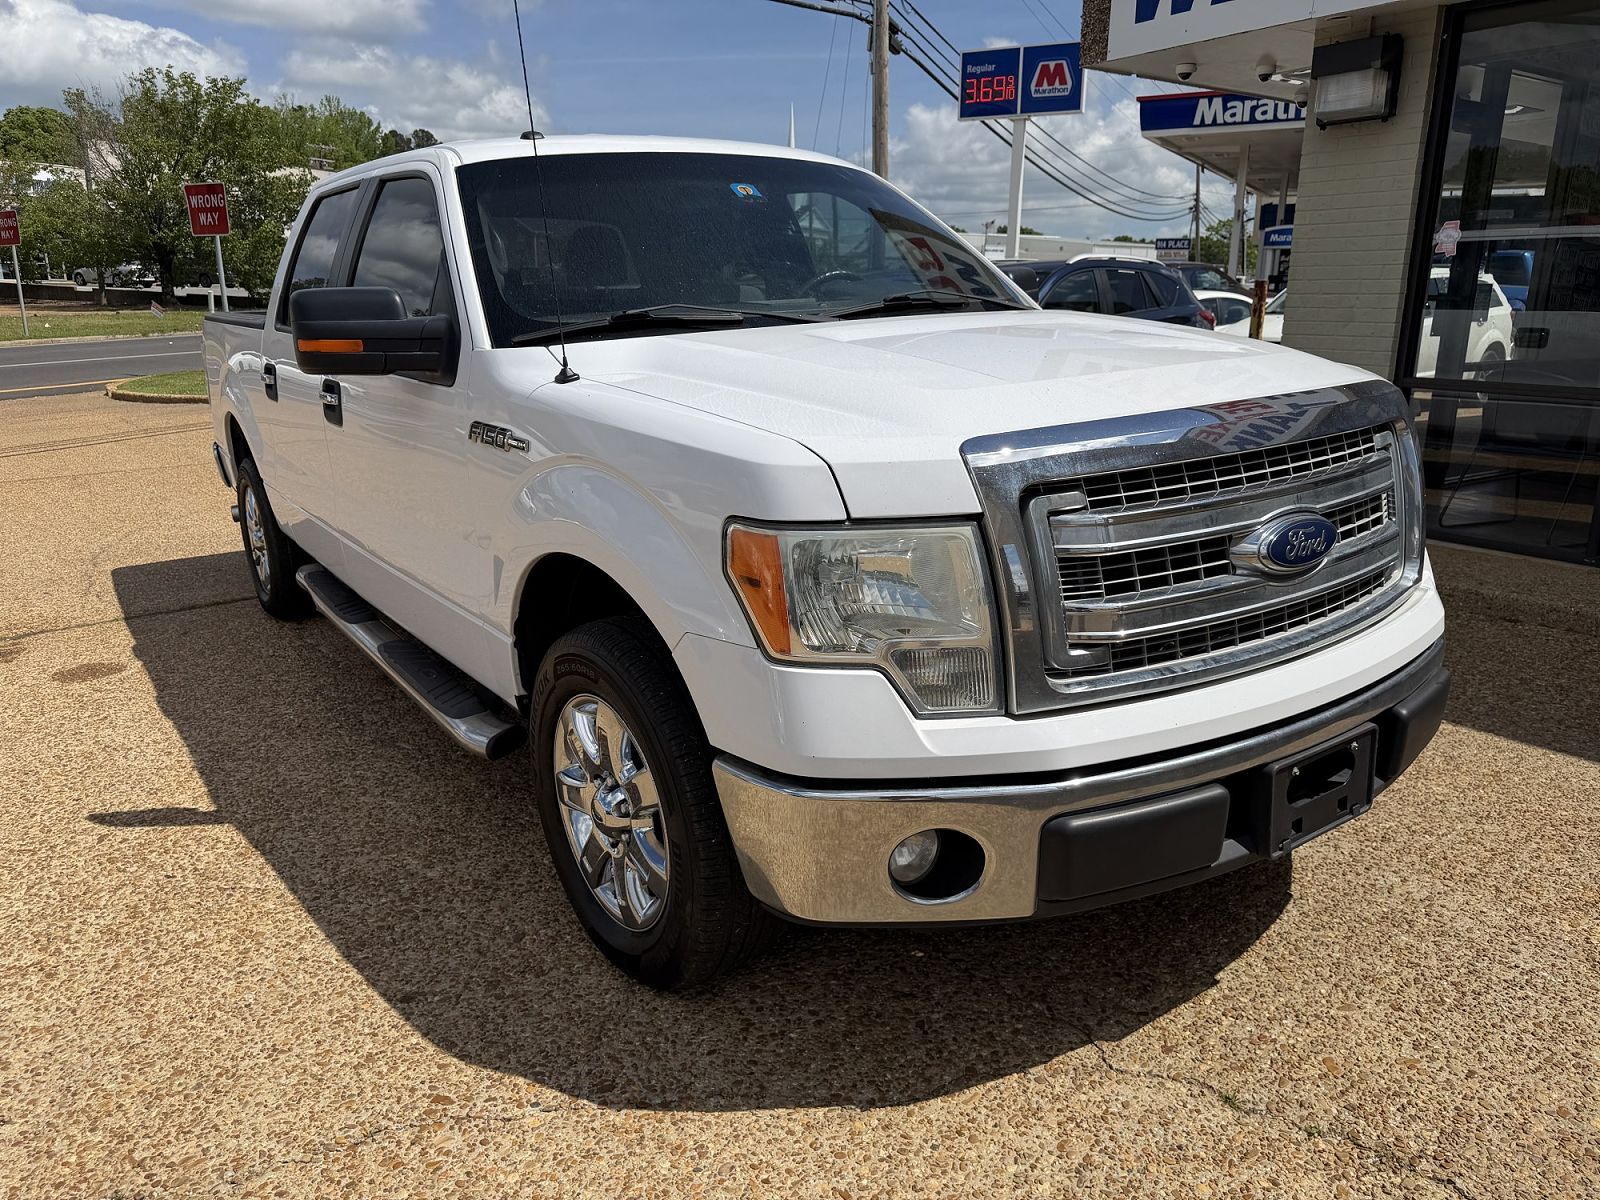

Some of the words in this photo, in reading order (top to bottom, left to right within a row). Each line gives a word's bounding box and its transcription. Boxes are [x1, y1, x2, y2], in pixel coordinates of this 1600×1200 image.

[966, 64, 996, 75] Regular
[965, 76, 1006, 104] 3.69
[1033, 86, 1069, 96] Marathon
[189, 193, 225, 208] WRONG
[0, 217, 17, 228] RONG
[198, 211, 219, 226] WAY
[0, 229, 14, 239] WAY
[1167, 239, 1190, 249] PLACE
[1286, 525, 1327, 561] Ford
